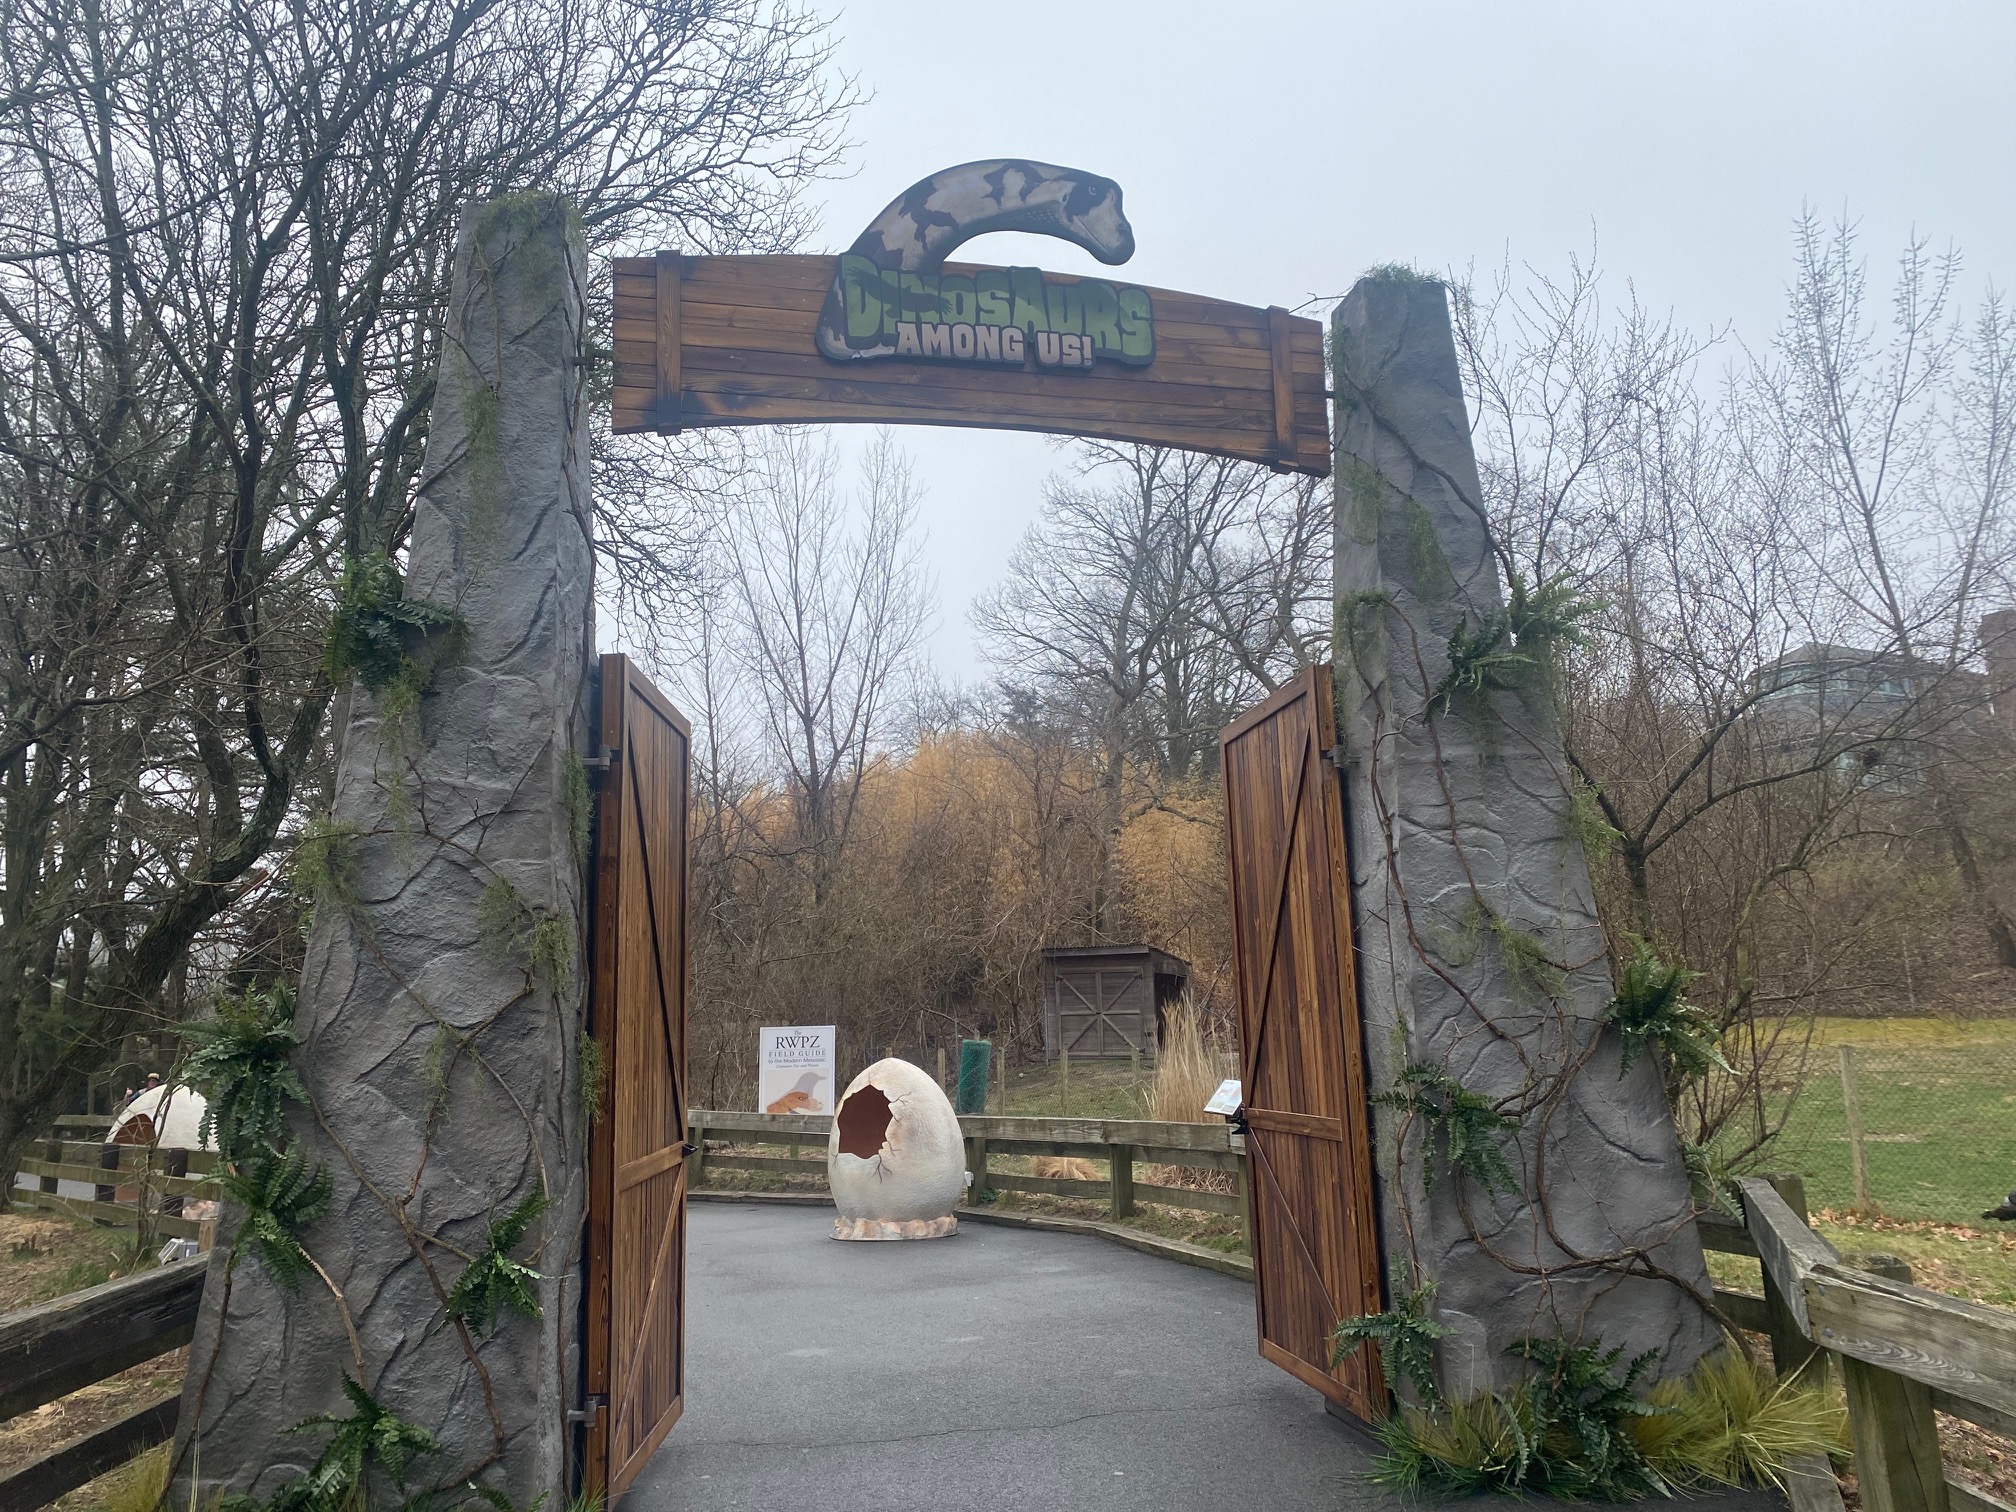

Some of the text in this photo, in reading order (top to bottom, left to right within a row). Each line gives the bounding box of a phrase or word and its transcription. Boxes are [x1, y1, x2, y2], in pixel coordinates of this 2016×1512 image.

[841, 255, 1151, 357] DINOSAURS
[897, 322, 1093, 366] AMONG US!
[776, 1036, 820, 1049] RWPZ
